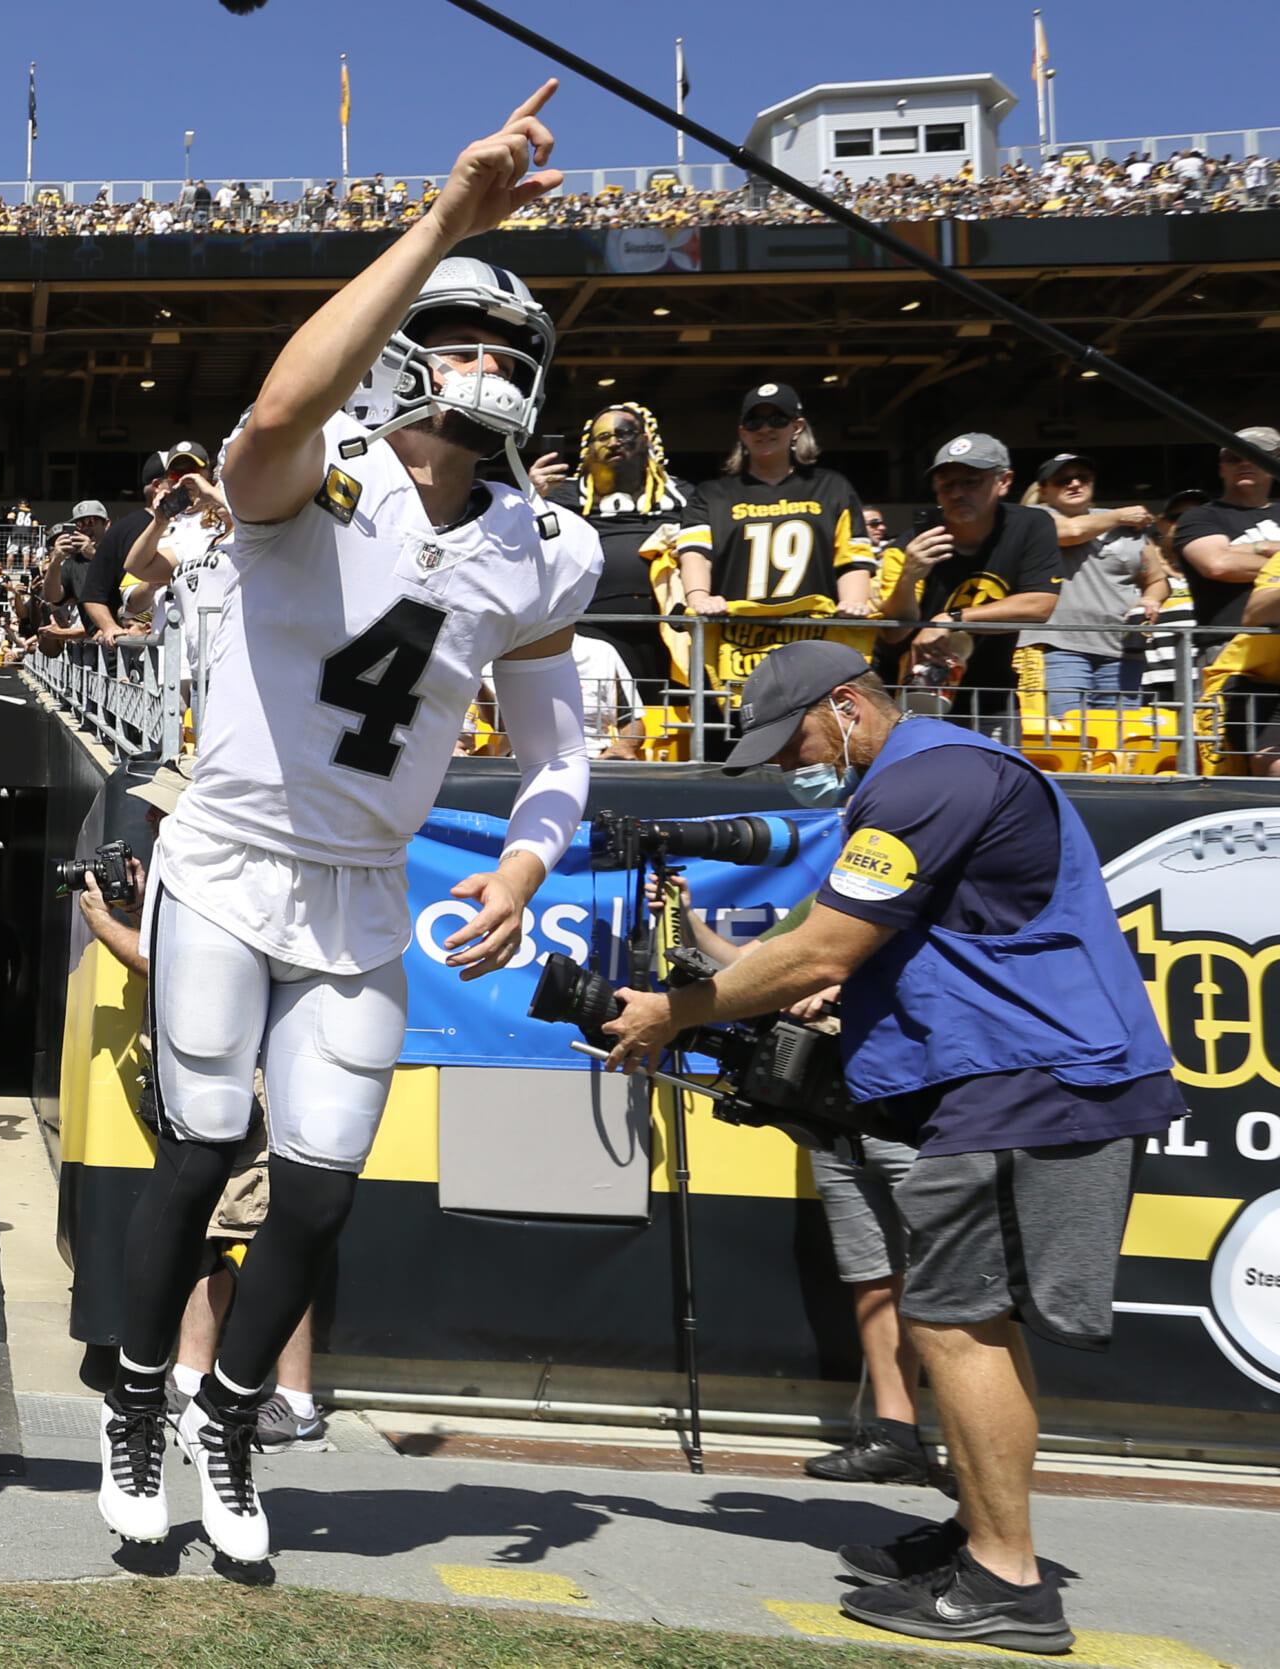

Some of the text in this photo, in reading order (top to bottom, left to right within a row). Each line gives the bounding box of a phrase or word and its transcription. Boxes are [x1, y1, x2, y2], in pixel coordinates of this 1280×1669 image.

[732, 499, 822, 521] Steelers
[743, 519, 814, 601] 19
[316, 593, 454, 782] 4
[844, 851, 881, 872] WEEK
[880, 862, 893, 876] 2
[670, 906, 682, 948] NIKO
[1235, 1111, 1280, 1161] O
[1245, 1267, 1280, 1287] Stee
